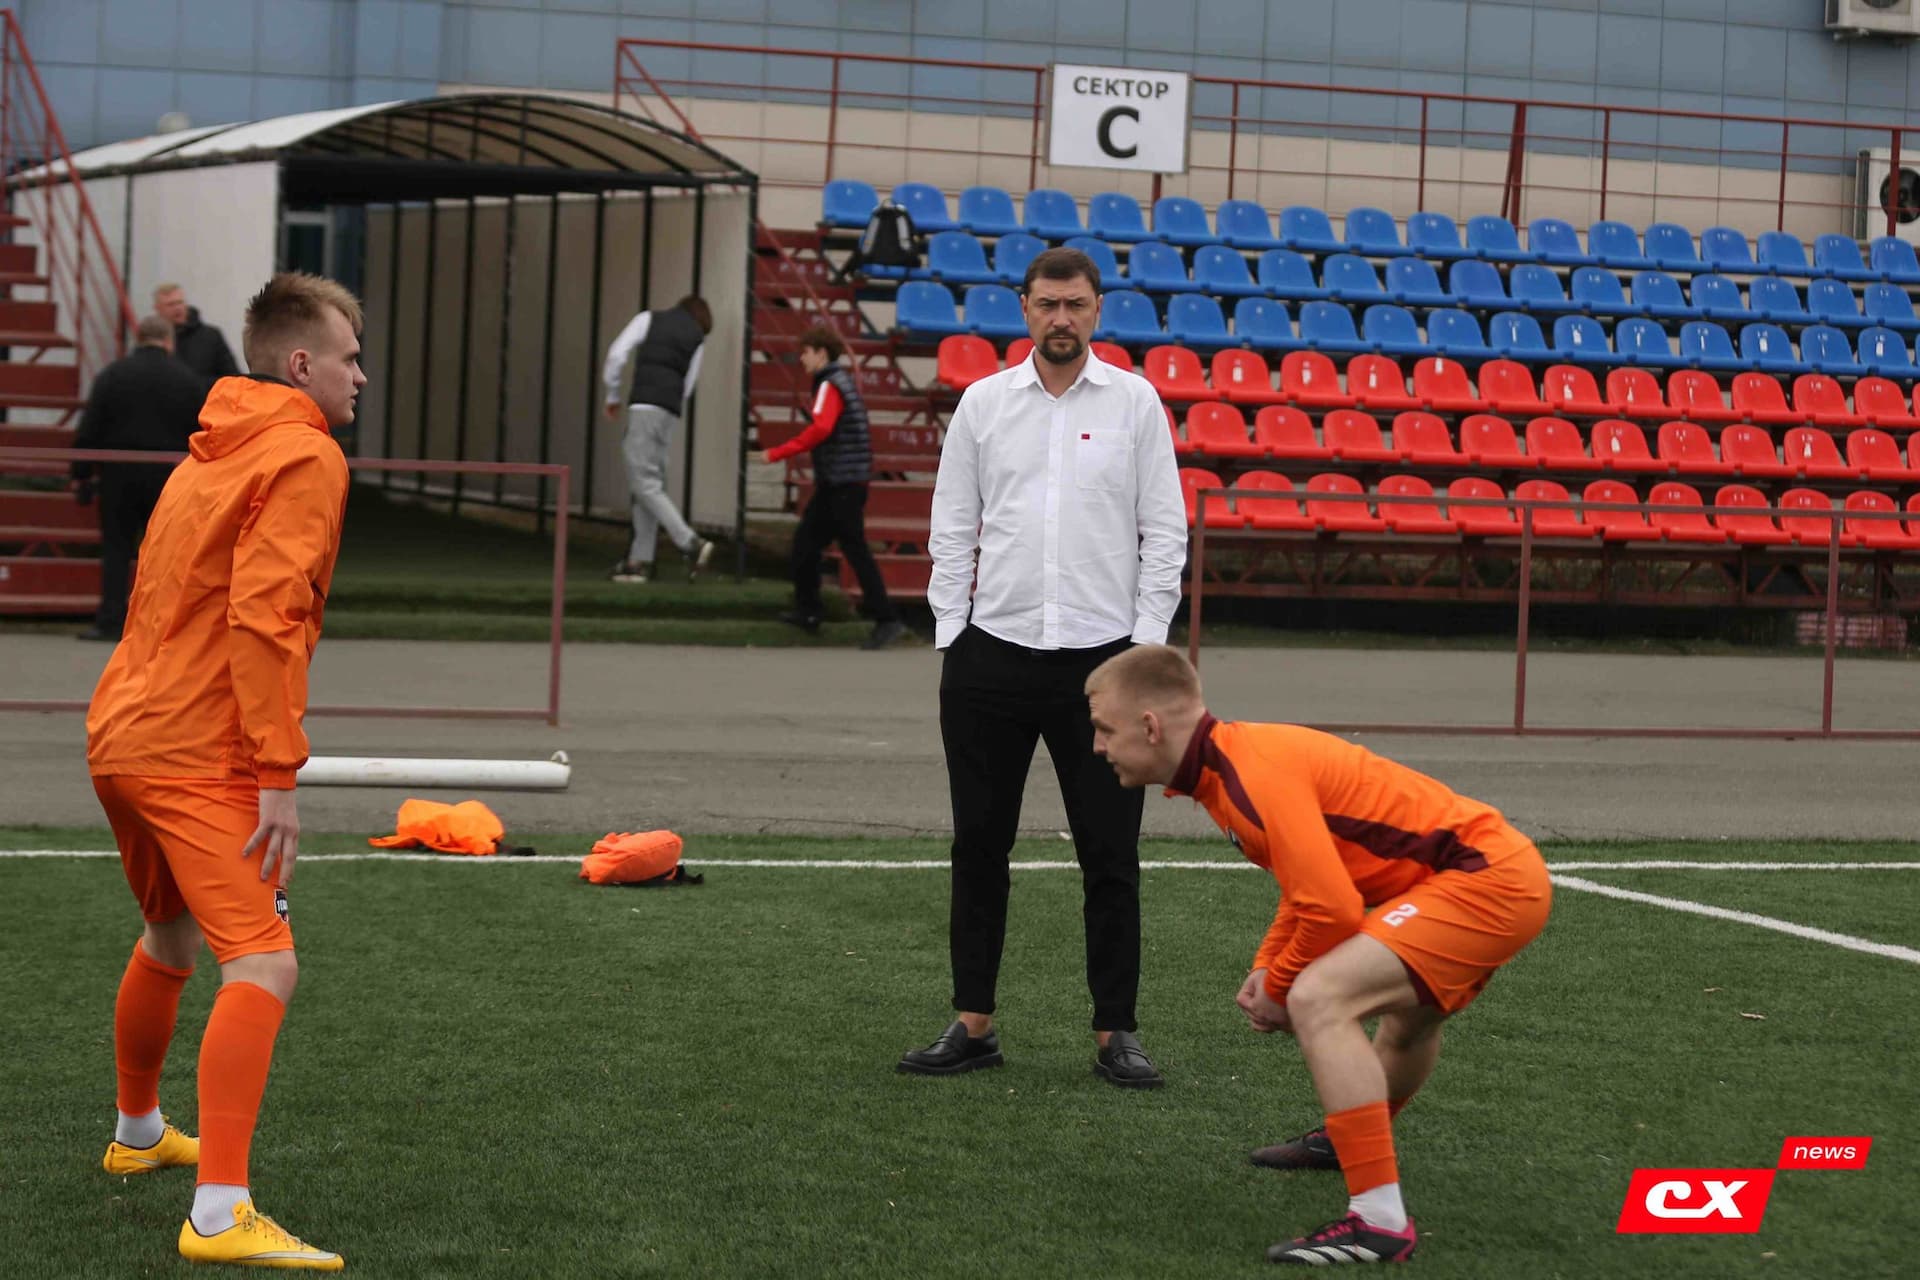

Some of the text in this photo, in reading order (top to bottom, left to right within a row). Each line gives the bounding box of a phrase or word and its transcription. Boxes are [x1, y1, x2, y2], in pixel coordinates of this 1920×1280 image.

[1073, 76, 1169, 99] СЕКТОР
[1096, 105, 1140, 159] С
[1382, 903, 1418, 928] 2
